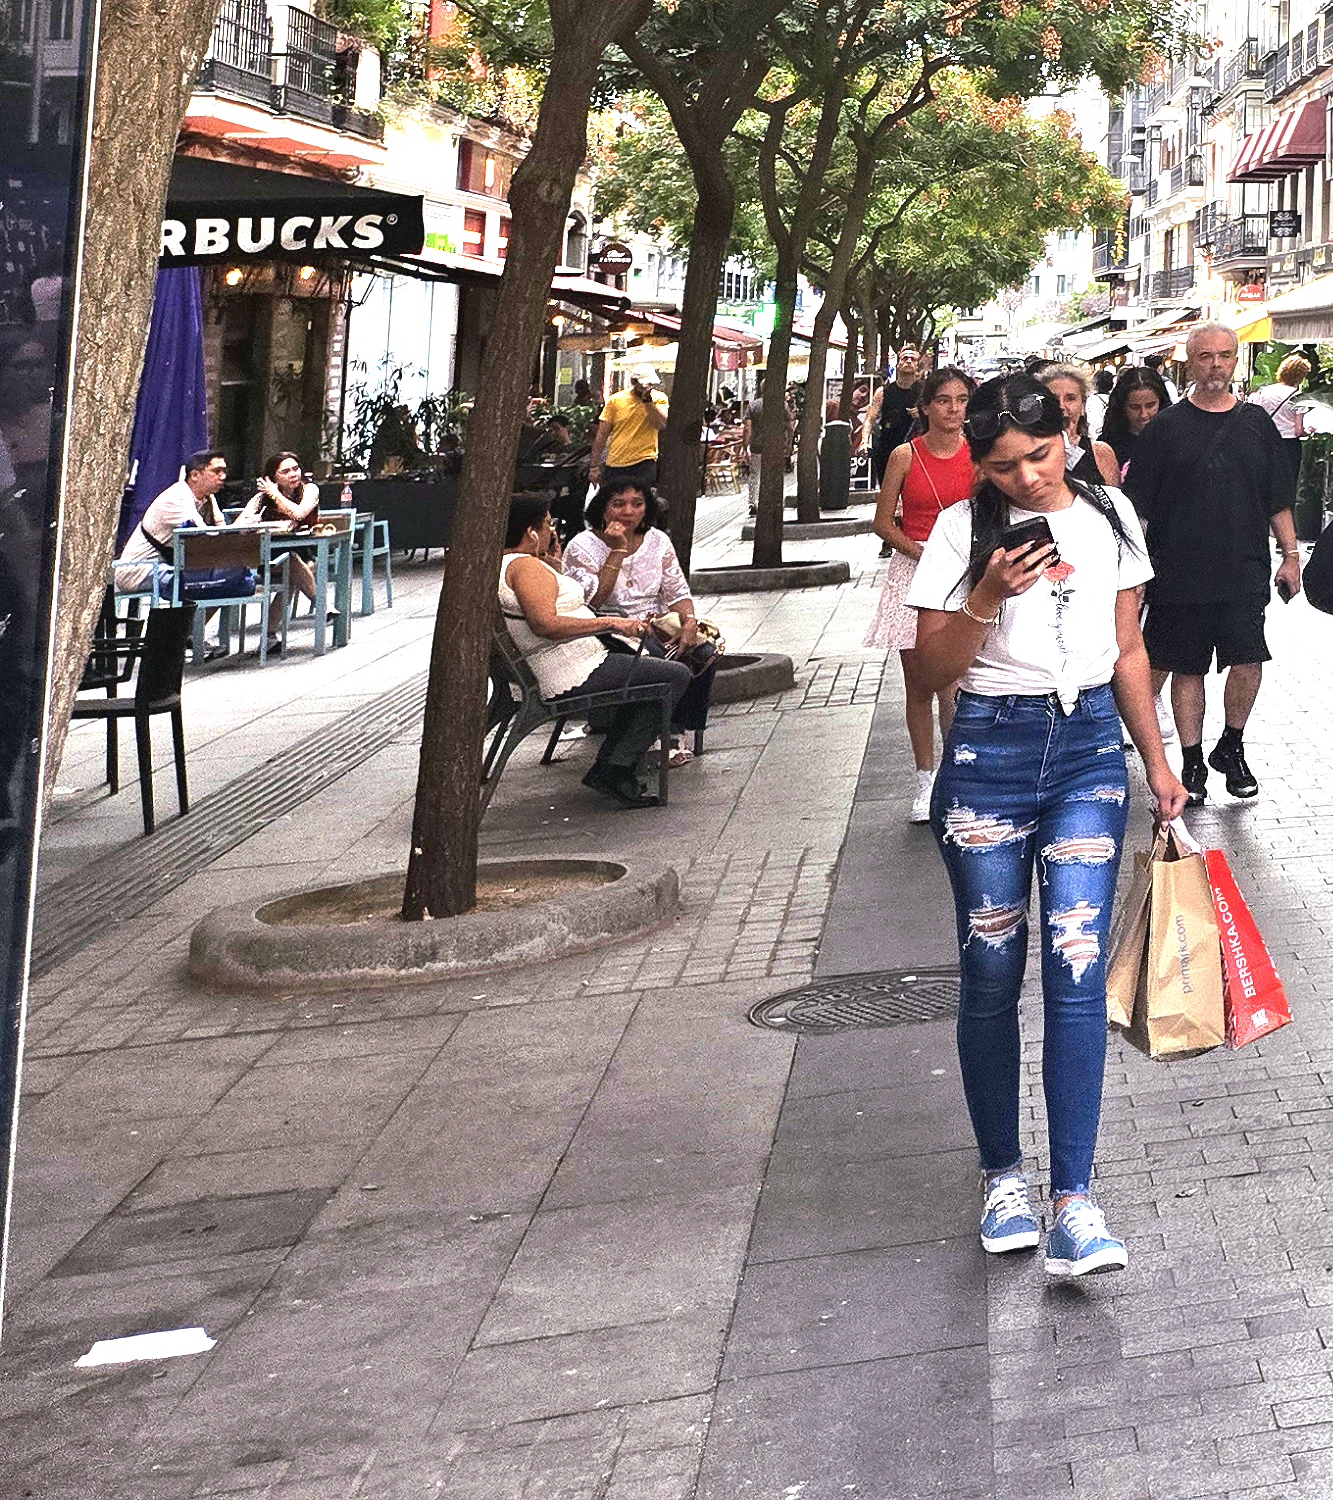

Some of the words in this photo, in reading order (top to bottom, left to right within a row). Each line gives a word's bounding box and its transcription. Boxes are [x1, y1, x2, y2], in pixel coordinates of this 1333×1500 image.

[159, 214, 384, 257] RBUCKS
[1175, 914, 1194, 994] primark.com
[1214, 887, 1257, 998] BERSHKA.COM
